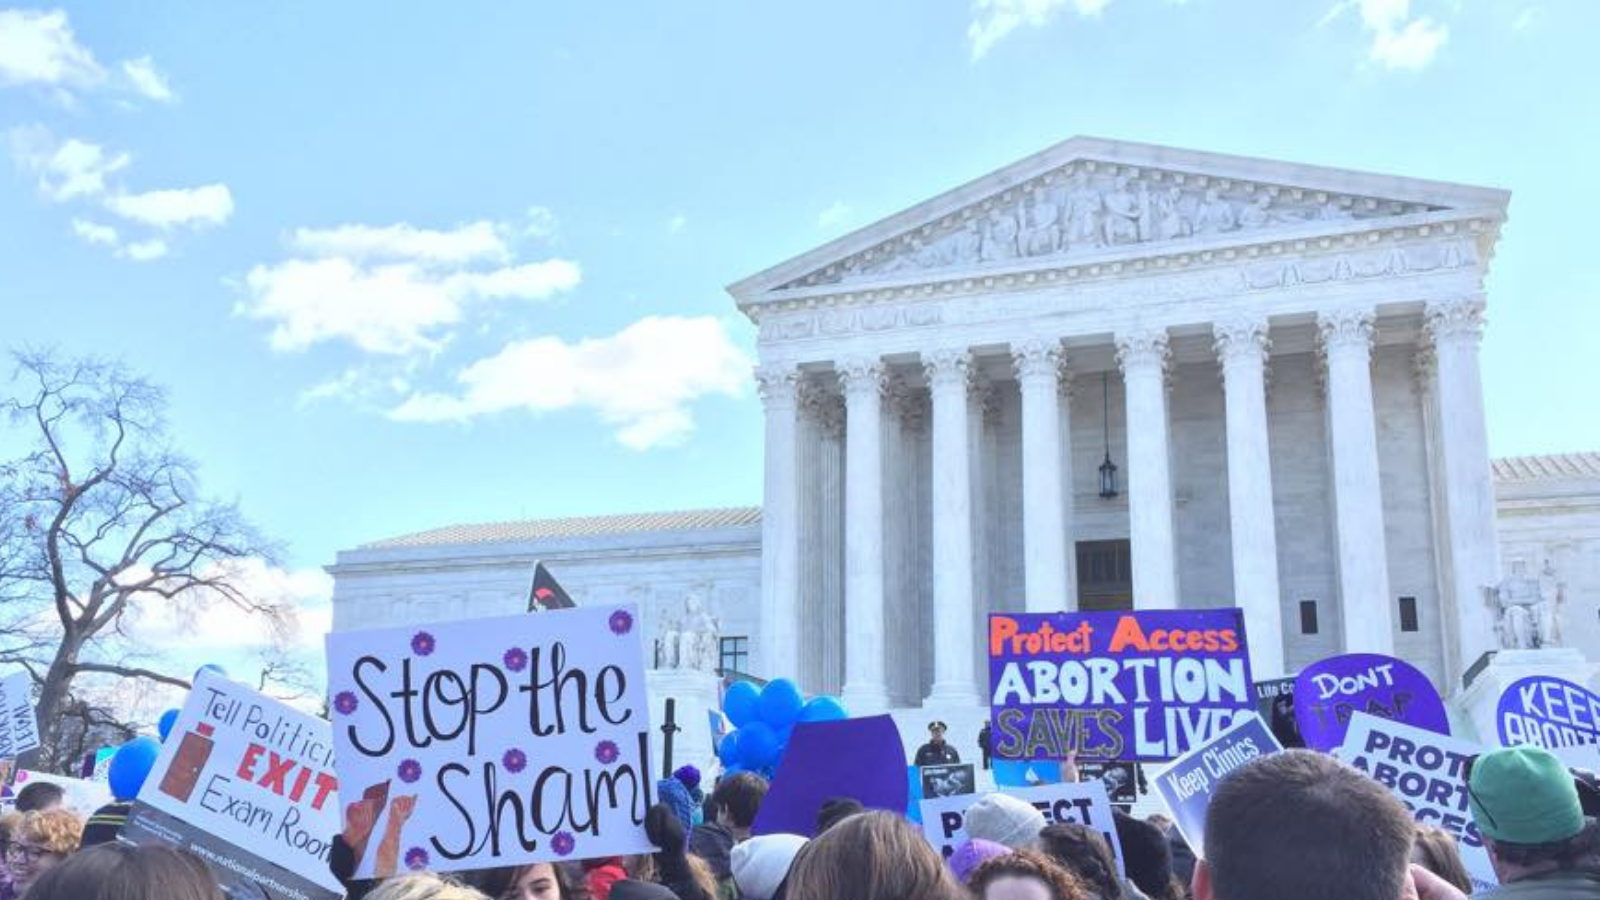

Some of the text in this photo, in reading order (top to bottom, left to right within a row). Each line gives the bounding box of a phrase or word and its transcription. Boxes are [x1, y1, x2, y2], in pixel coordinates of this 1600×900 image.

[990, 615, 1239, 656] Protect Access
[348, 642, 632, 757] Stop the
[993, 657, 1249, 705] ABORTION
[204, 687, 336, 767] Tell Politici
[996, 706, 1259, 758] SAVES LIVE
[1364, 729, 1465, 777] PROT
[236, 742, 339, 811] EXIT
[1167, 737, 1260, 802] Keep Clinics
[1352, 756, 1469, 812] ABORT
[200, 773, 273, 834] Exam
